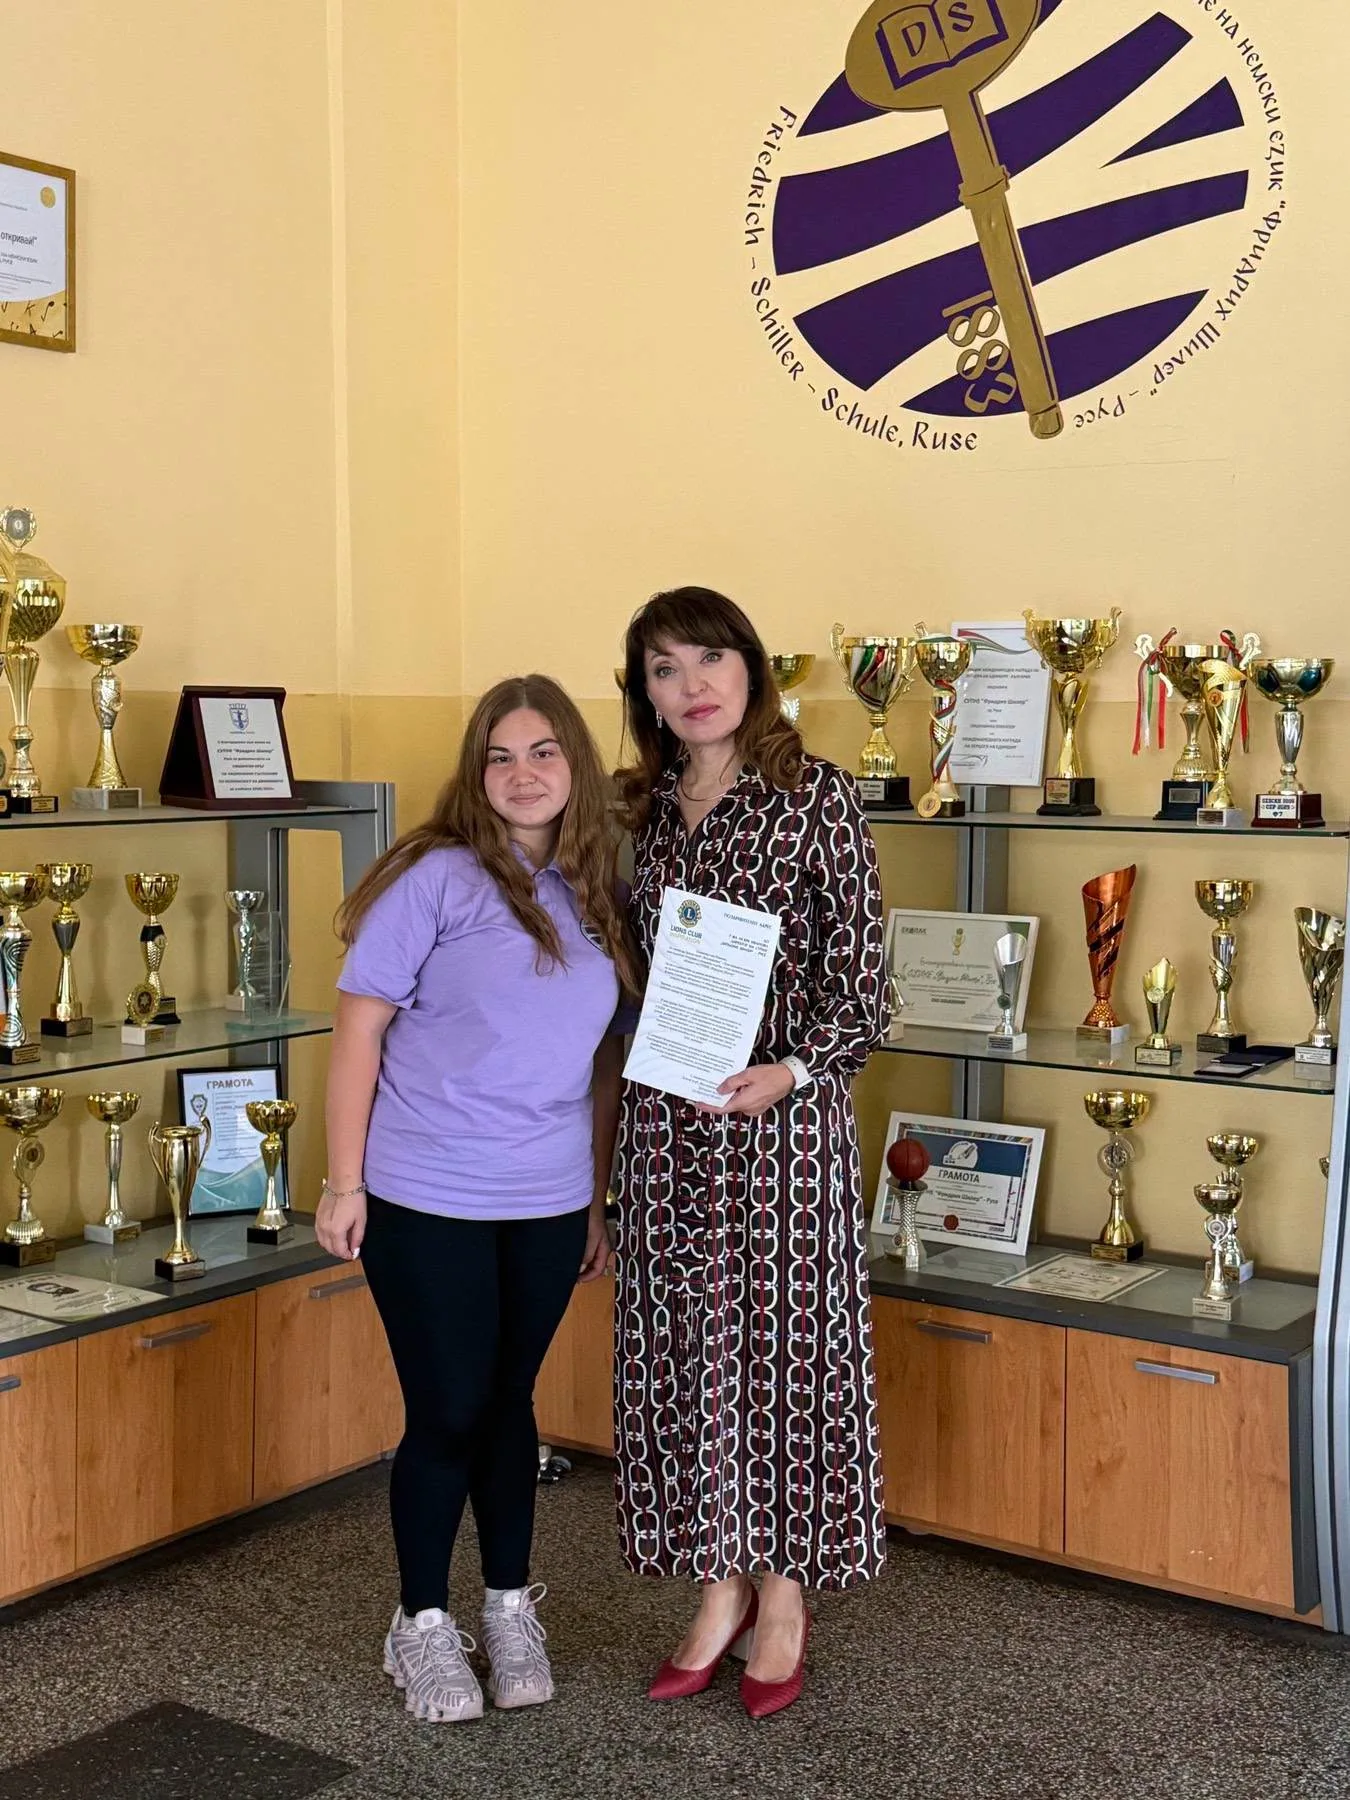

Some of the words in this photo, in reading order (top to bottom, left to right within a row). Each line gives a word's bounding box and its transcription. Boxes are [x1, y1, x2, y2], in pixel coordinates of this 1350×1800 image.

[901, 21, 927, 57] D
[947, 1, 975, 33] S
[750, 276, 805, 382] Schiller
[821, 387, 904, 449] Schule,
[911, 421, 978, 451] Ruse
[942, 290, 1017, 413] 1883
[1073, 394, 1126, 428] Русе
[670, 925, 687, 937] LIONS
[206, 1079, 254, 1090] ГРАМОТА
[937, 1168, 980, 1184] ГРАМОТА
